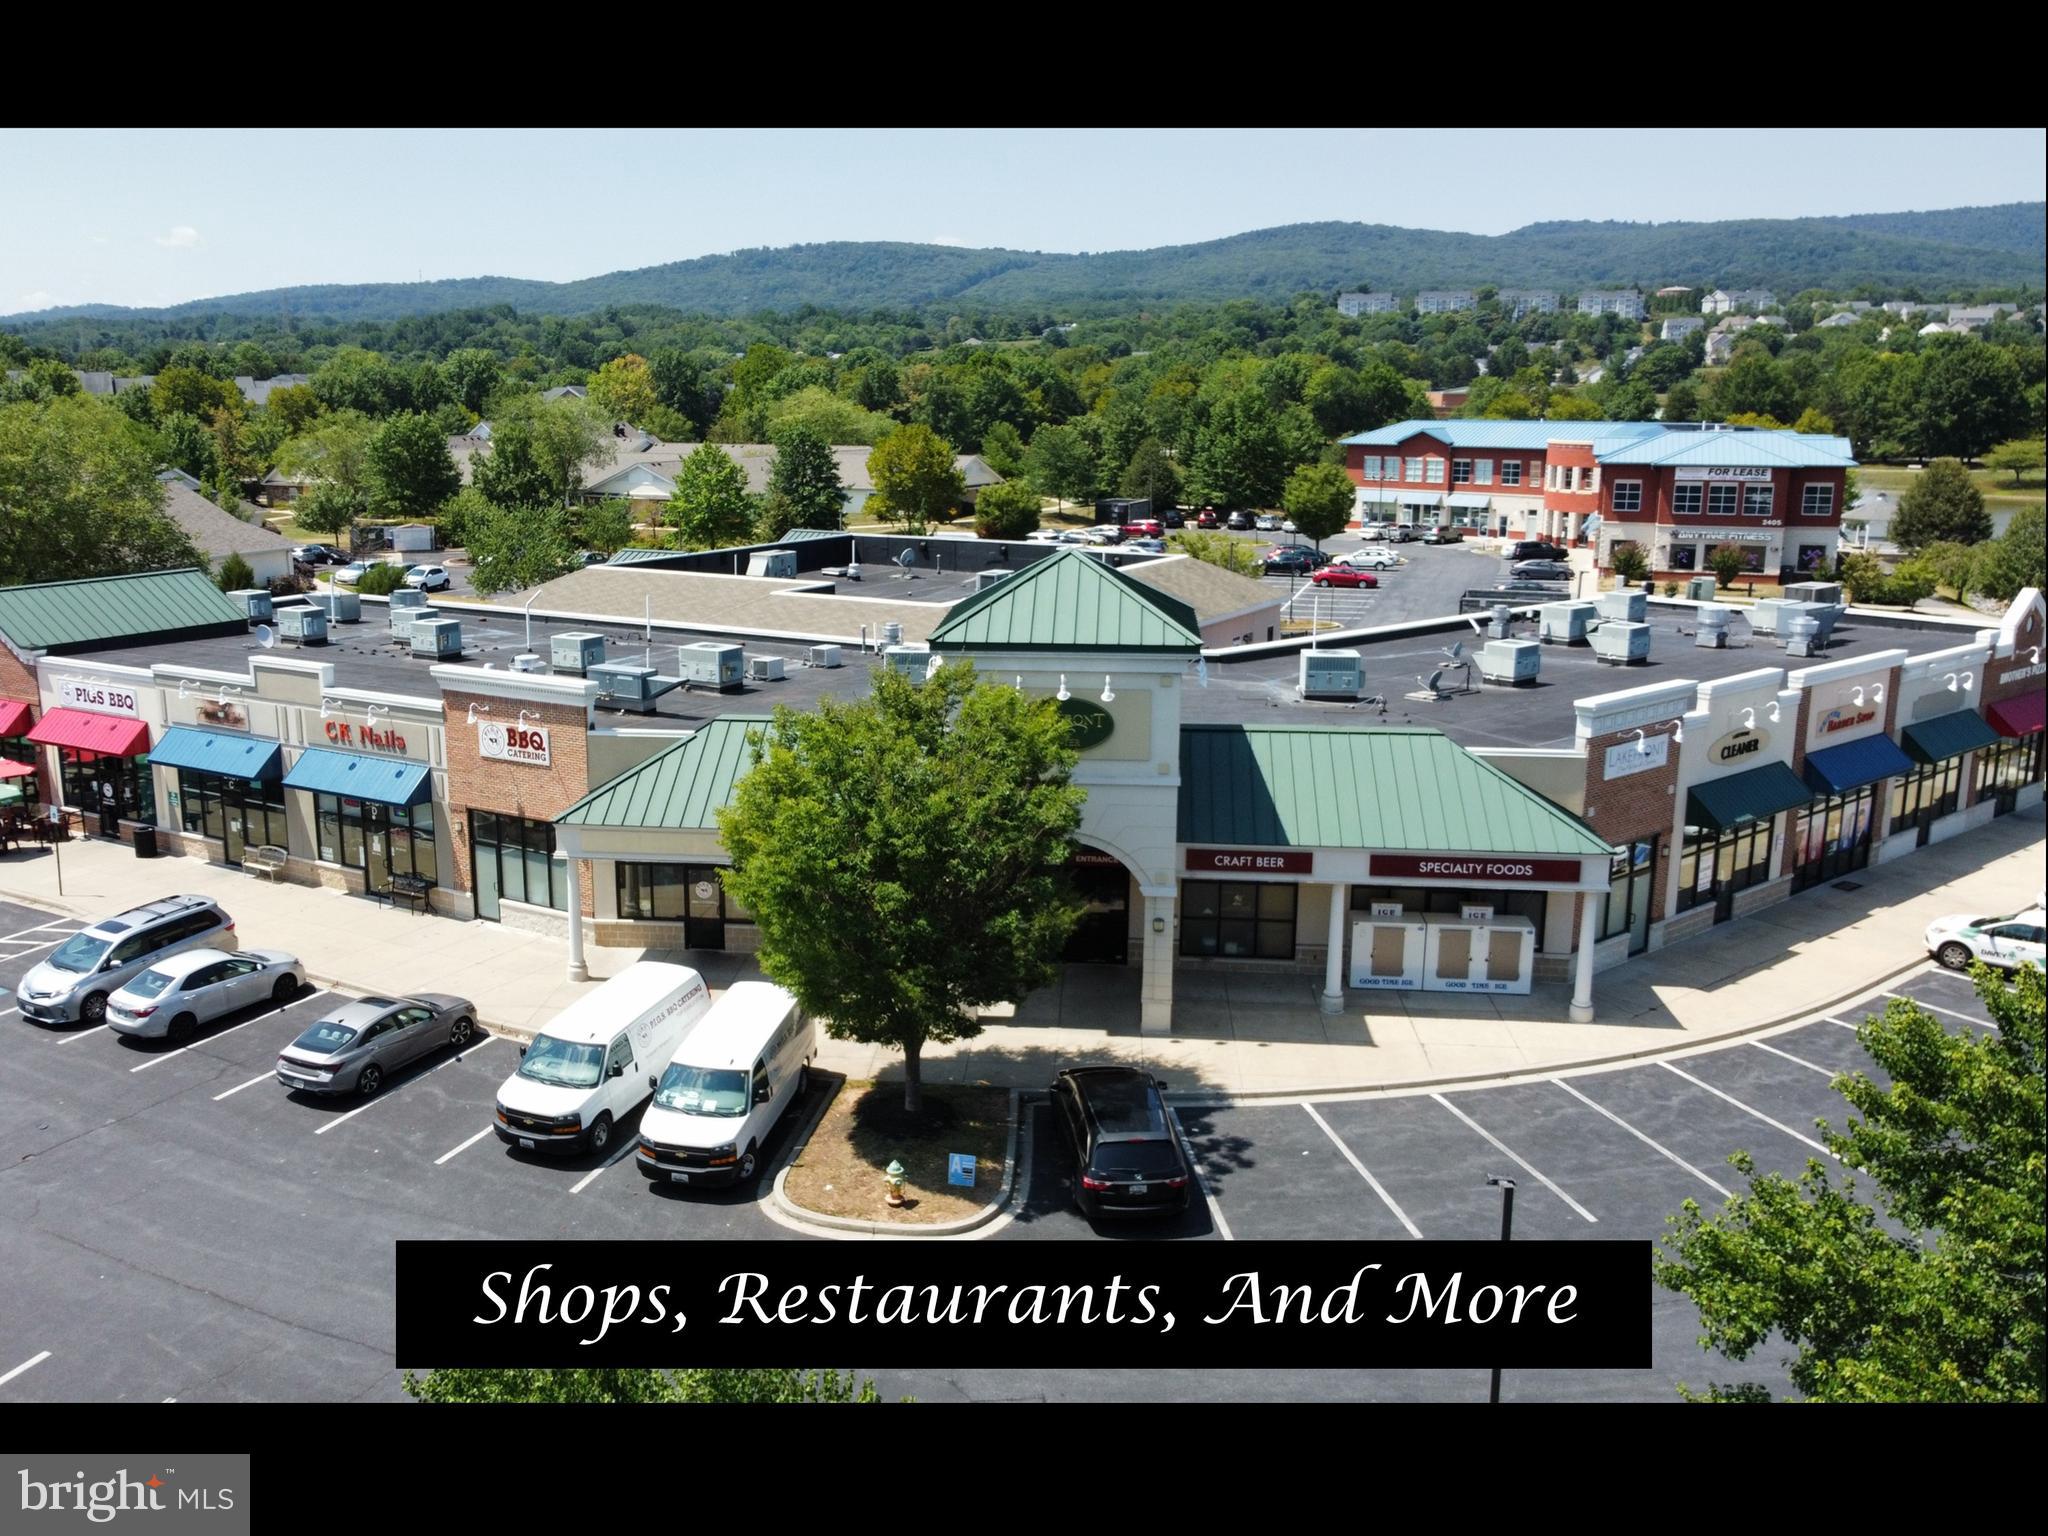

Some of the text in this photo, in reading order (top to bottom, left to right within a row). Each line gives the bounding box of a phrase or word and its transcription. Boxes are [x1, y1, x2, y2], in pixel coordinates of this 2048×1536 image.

[1708, 467, 1730, 477] FOR
[1733, 467, 1768, 477] LEASE
[1729, 531, 1773, 541] FITNESS
[108, 691, 135, 711] BBQ
[359, 724, 407, 750] Nails
[506, 726, 546, 752] BBQ
[507, 748, 547, 762] CATERING
[1720, 738, 1760, 760] CLEANER
[1214, 855, 1285, 868] CRAFT BEER
[1419, 862, 1533, 876] SPECIALTY FOODS
